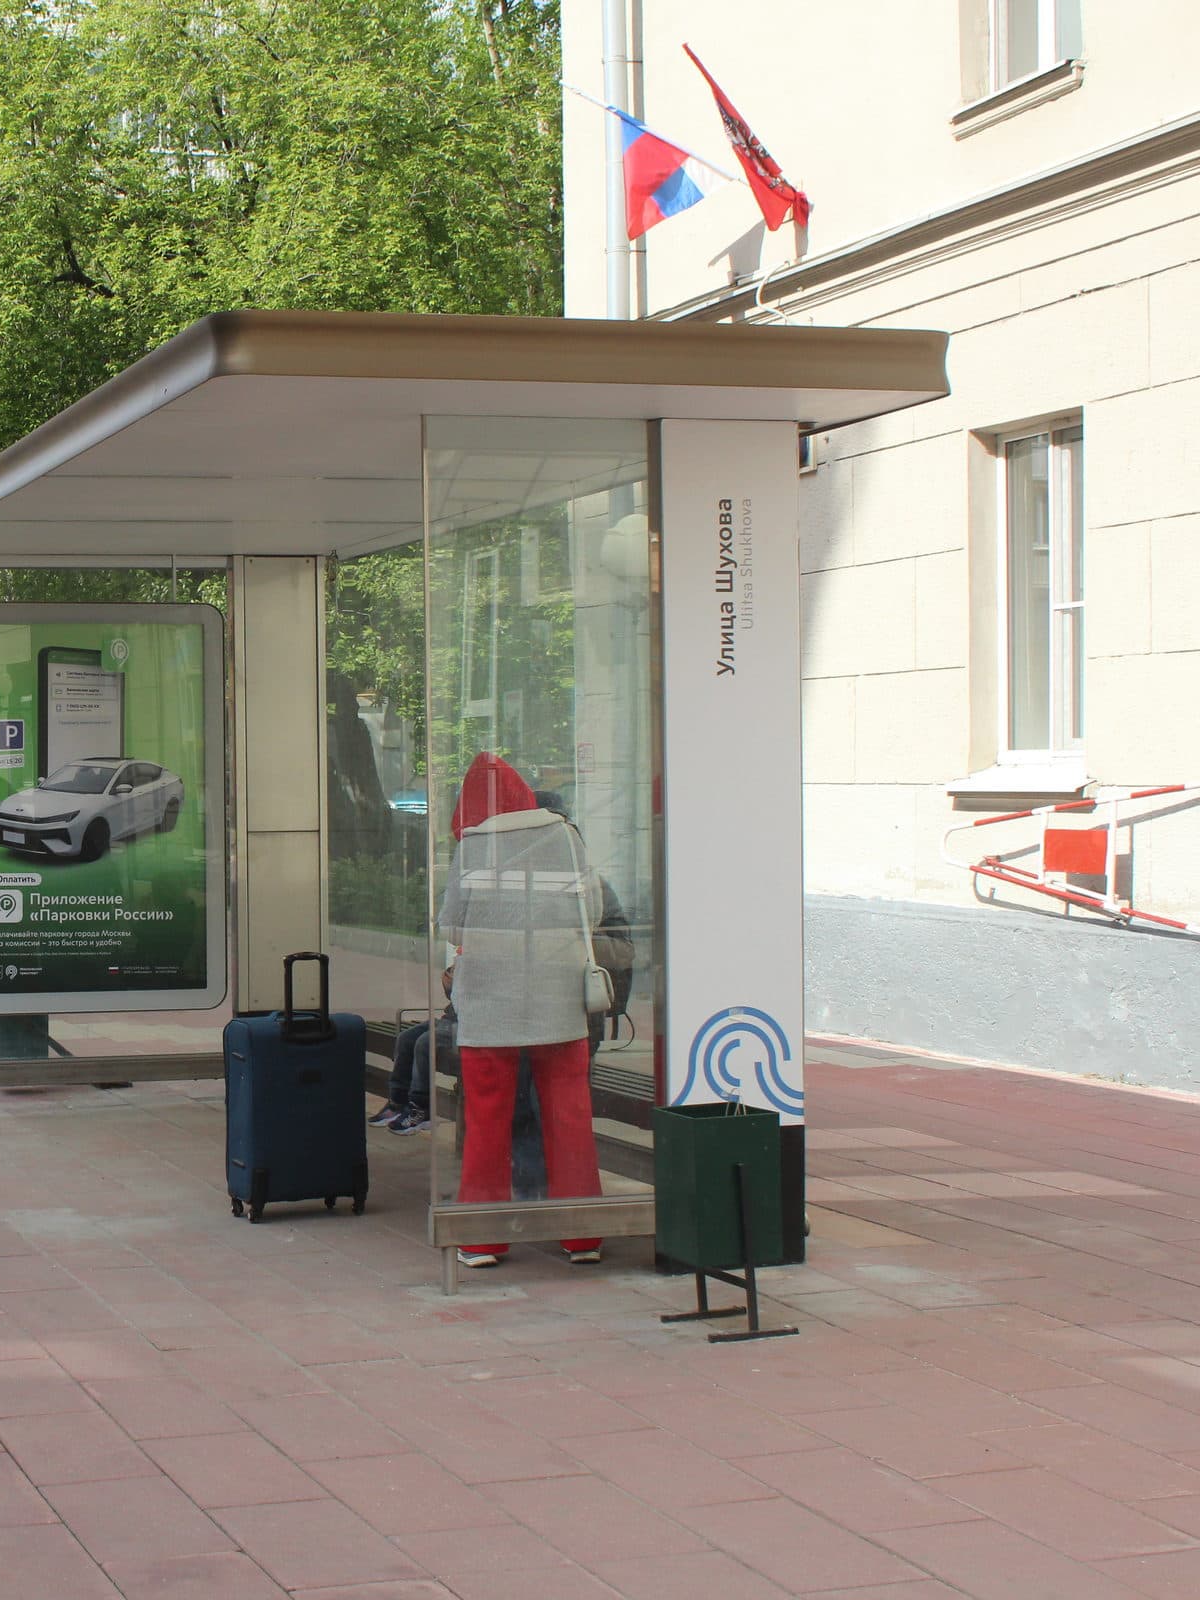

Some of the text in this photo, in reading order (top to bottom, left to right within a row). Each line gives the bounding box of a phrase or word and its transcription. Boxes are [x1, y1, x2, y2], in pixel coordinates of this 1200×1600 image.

[739, 498, 753, 630] Ulitsa Shukhova
[715, 498, 737, 676] Улица Шухова
[6, 725, 18, 747] P
[30, 893, 123, 908] Приложение
[30, 908, 174, 923] «Парковки России»
[40, 931, 74, 939] парковку
[61, 938, 89, 947] быстро
[95, 938, 122, 947] удобно
